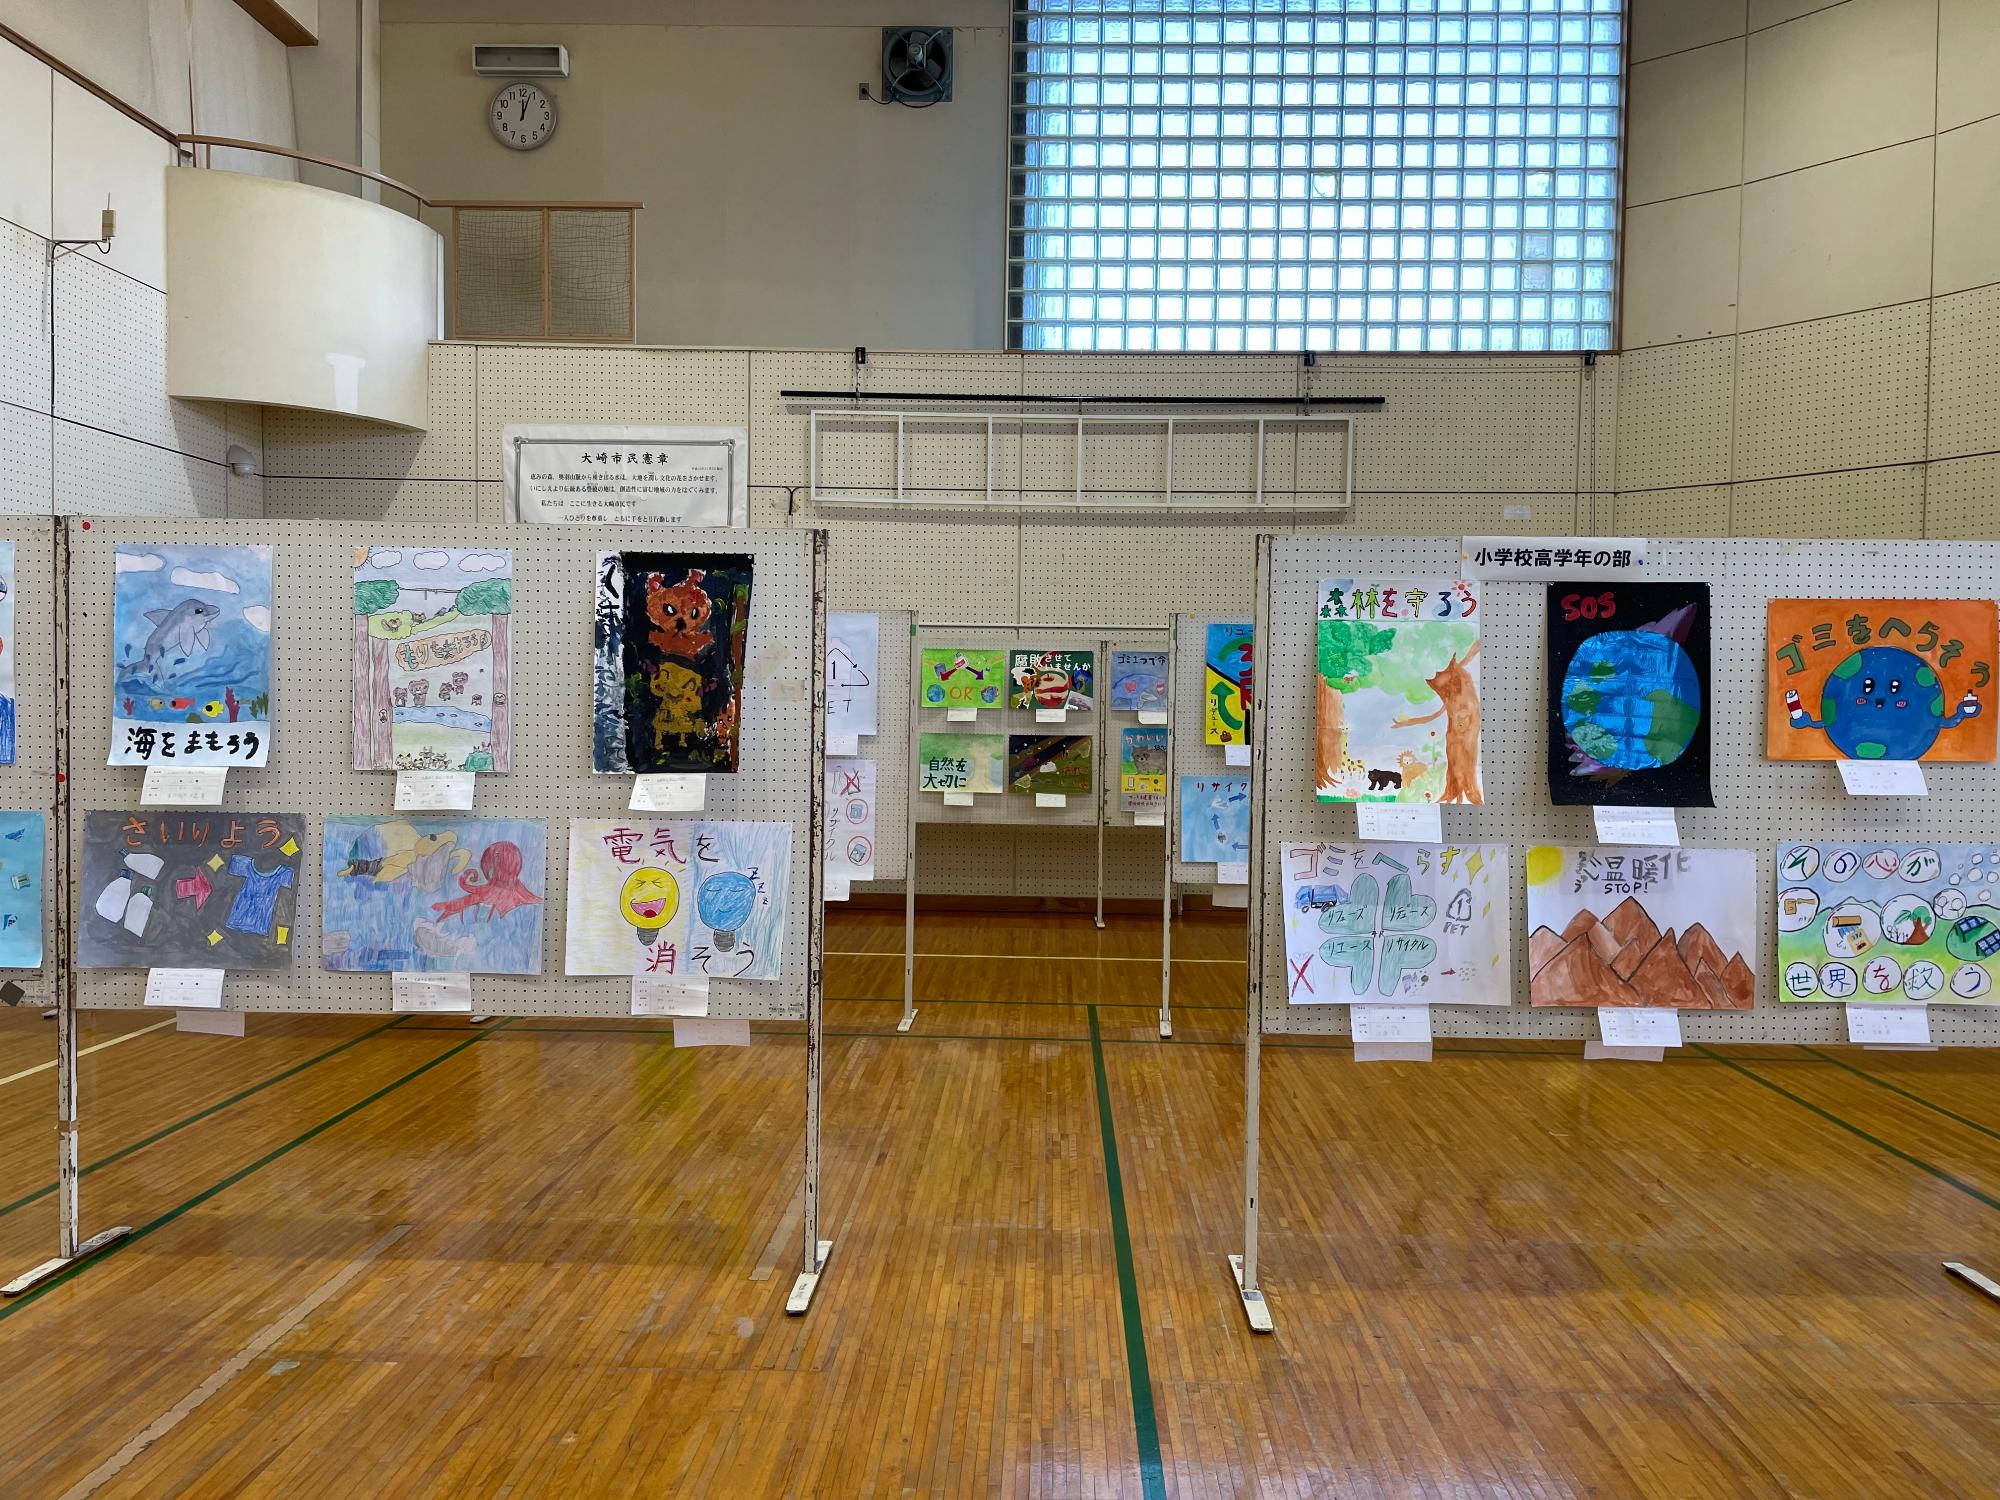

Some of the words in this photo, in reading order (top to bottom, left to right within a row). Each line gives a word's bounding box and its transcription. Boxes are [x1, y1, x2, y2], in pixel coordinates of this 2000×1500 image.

[509, 92, 516, 100] 11
[519, 88, 527, 97] 12
[501, 100, 508, 108] 10
[540, 100, 545, 108] 2
[497, 112, 502, 120] 9
[544, 112, 550, 120] 3
[502, 123, 508, 131] 8
[540, 123, 545, 132] 4
[510, 131, 516, 140] 7
[520, 135, 526, 143] 6
[532, 131, 538, 140] 5
[580, 451, 669, 466] 大崎市民憲章
[1474, 548, 1632, 568] 小学校高学年の部
[1319, 587, 1478, 619] 森林を守ろう
[1561, 591, 1617, 621] SOS
[1776, 614, 1990, 687] ゴミをへらそう
[949, 685, 973, 701] OR
[124, 726, 260, 760] 海をまもろう
[929, 756, 968, 772] 自然を
[922, 773, 967, 788] 大切に
[121, 815, 281, 849] さいりよう
[602, 827, 720, 865] 電気を
[1290, 842, 1461, 881] ゴミをへらす
[1604, 881, 1649, 894] STOP!
[1442, 921, 1471, 936] PET
[645, 940, 754, 977] 消そう
[1789, 964, 1982, 993] 世界を救う
